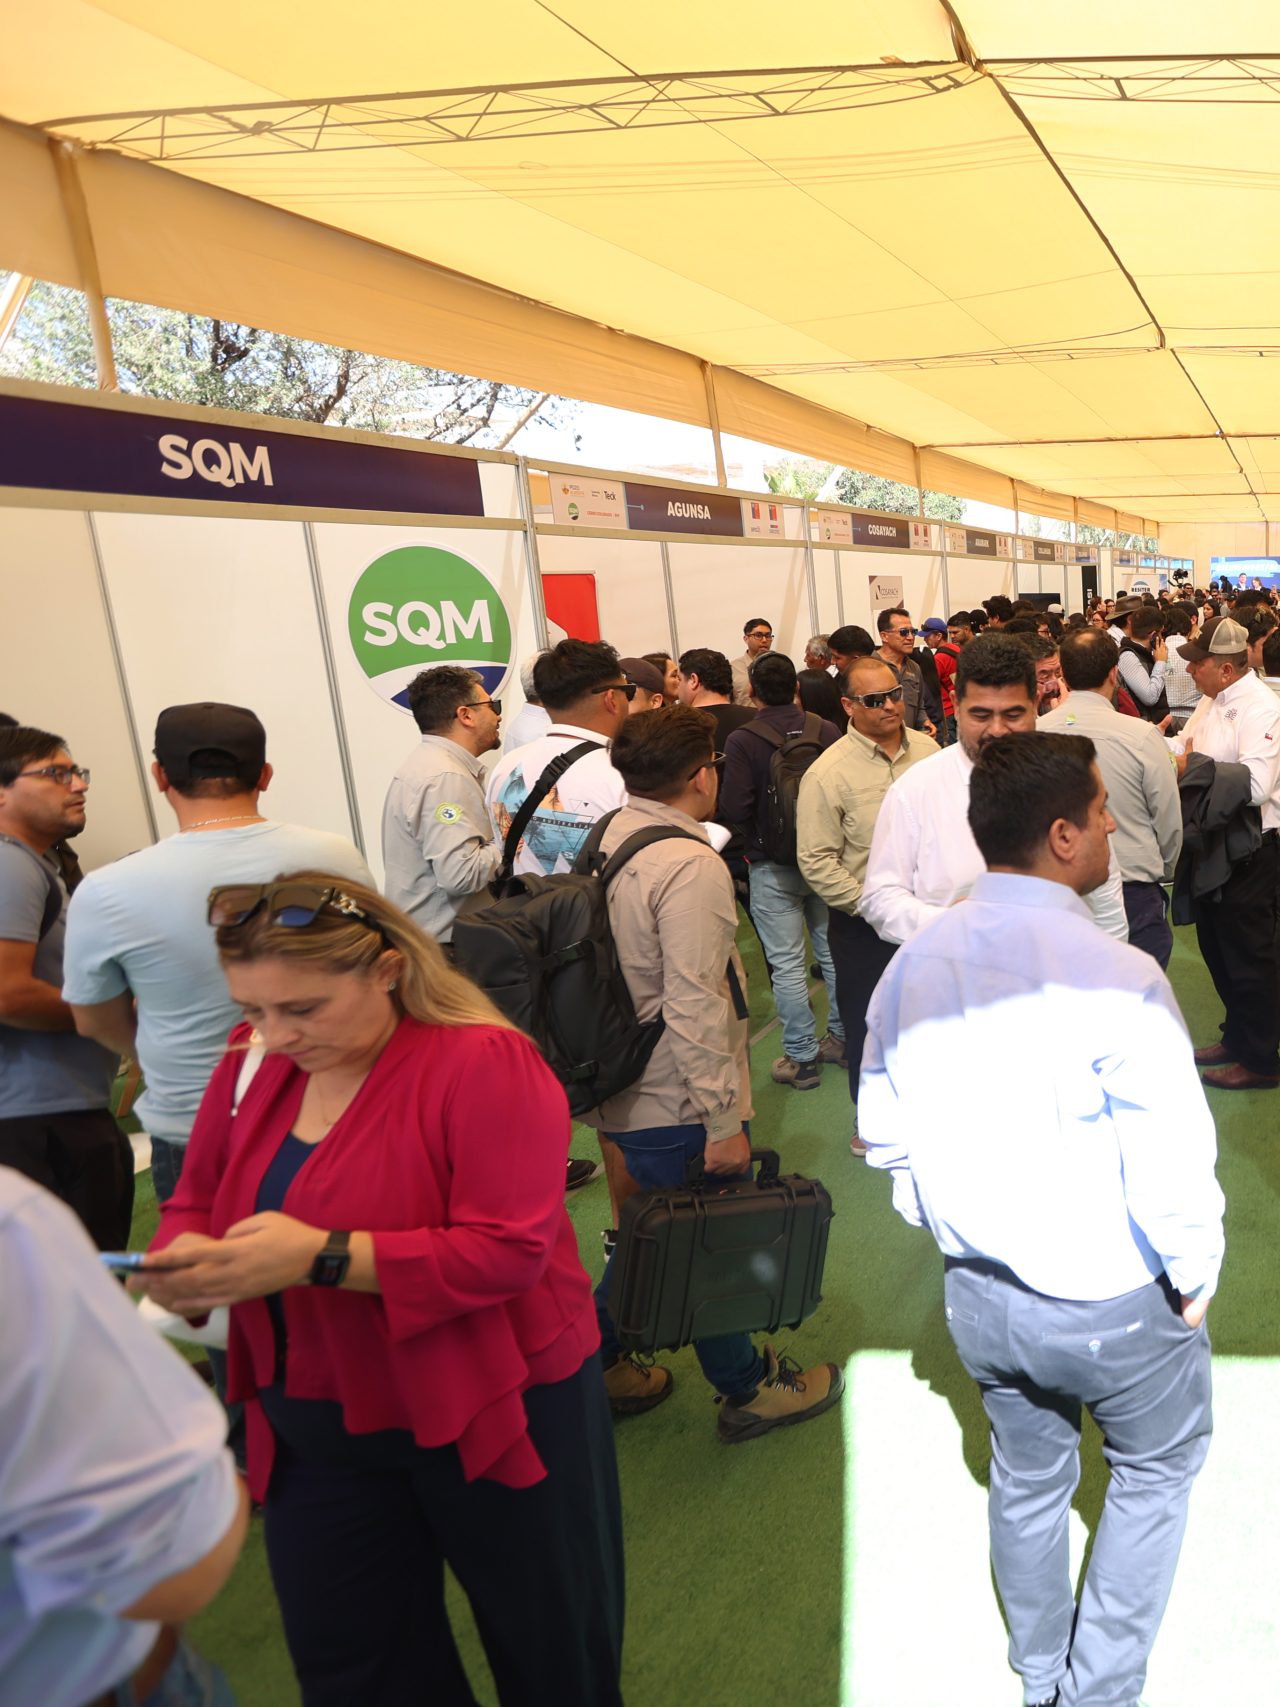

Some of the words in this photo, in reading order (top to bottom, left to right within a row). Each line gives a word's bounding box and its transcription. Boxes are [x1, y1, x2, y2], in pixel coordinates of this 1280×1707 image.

[158, 434, 274, 488] SQM
[667, 501, 711, 520] AGUNSA
[868, 524, 897, 538] COSAYACH
[362, 599, 494, 650] SQM
